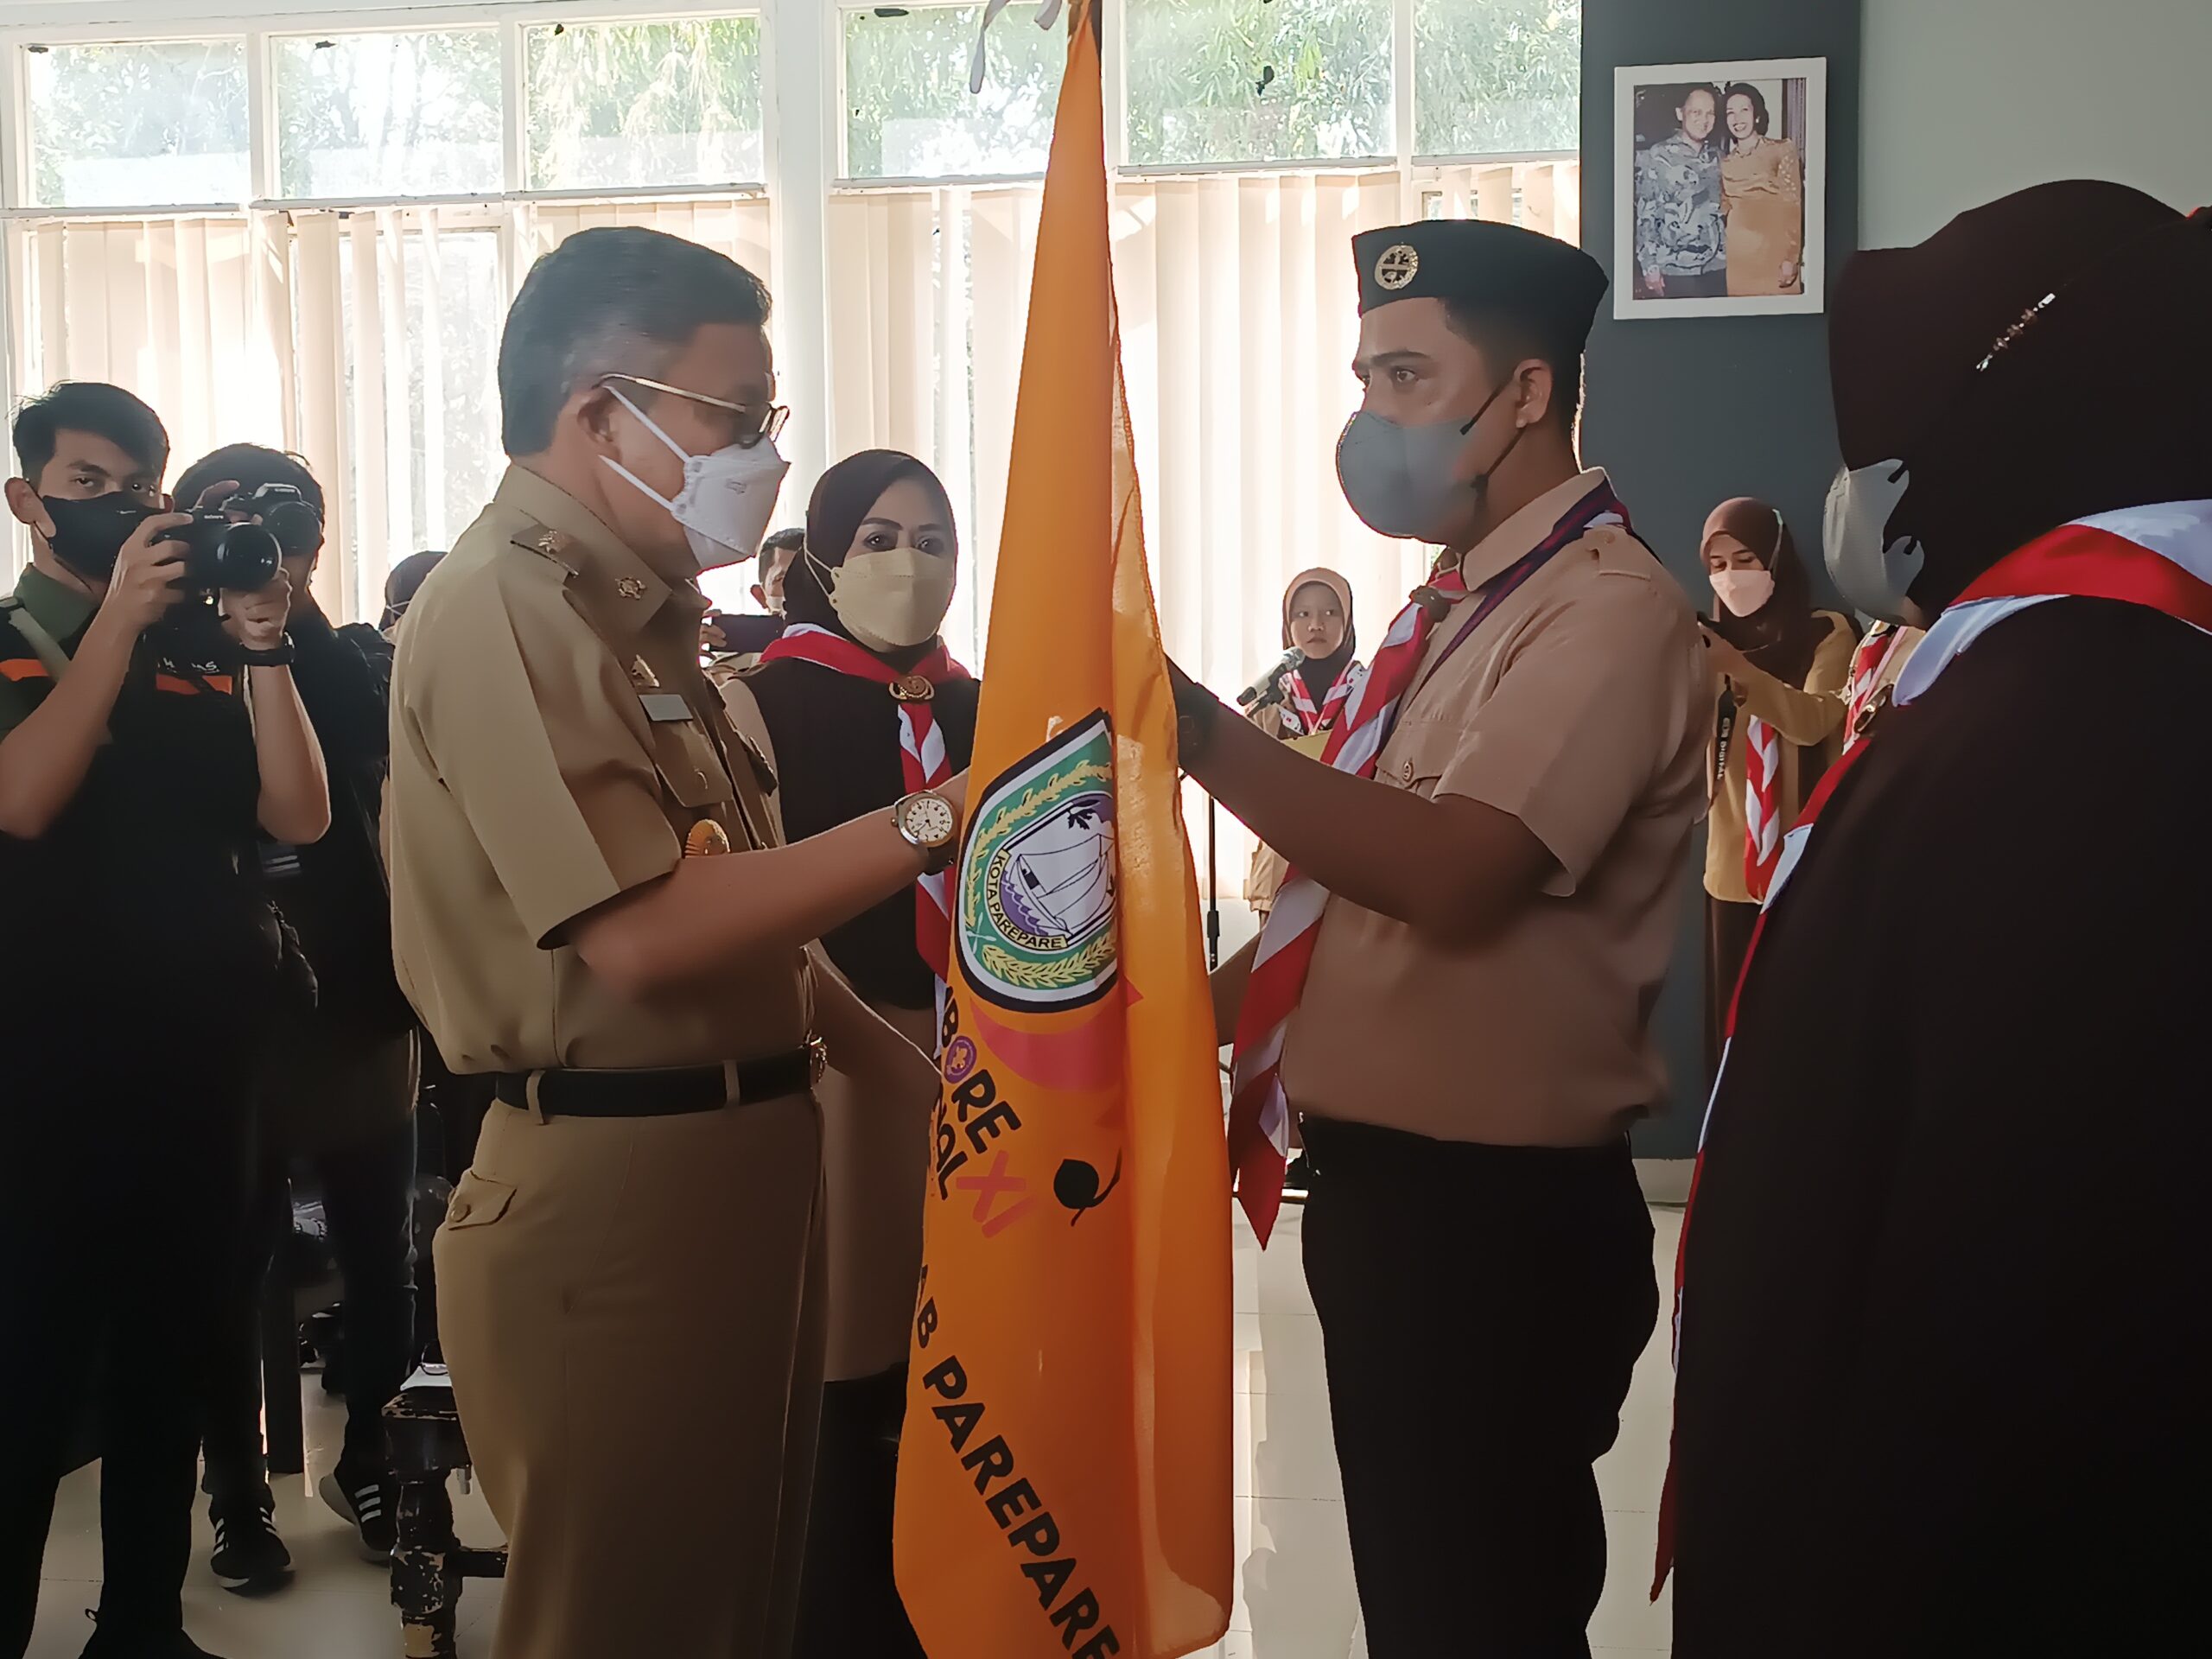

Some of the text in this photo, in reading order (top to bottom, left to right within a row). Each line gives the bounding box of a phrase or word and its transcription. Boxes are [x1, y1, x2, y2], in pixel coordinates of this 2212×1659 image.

[987, 855, 1062, 949] KOTA PAREPARE
[942, 986, 1022, 1154] BORE
[923, 1355, 1121, 1659] PAREPARE
